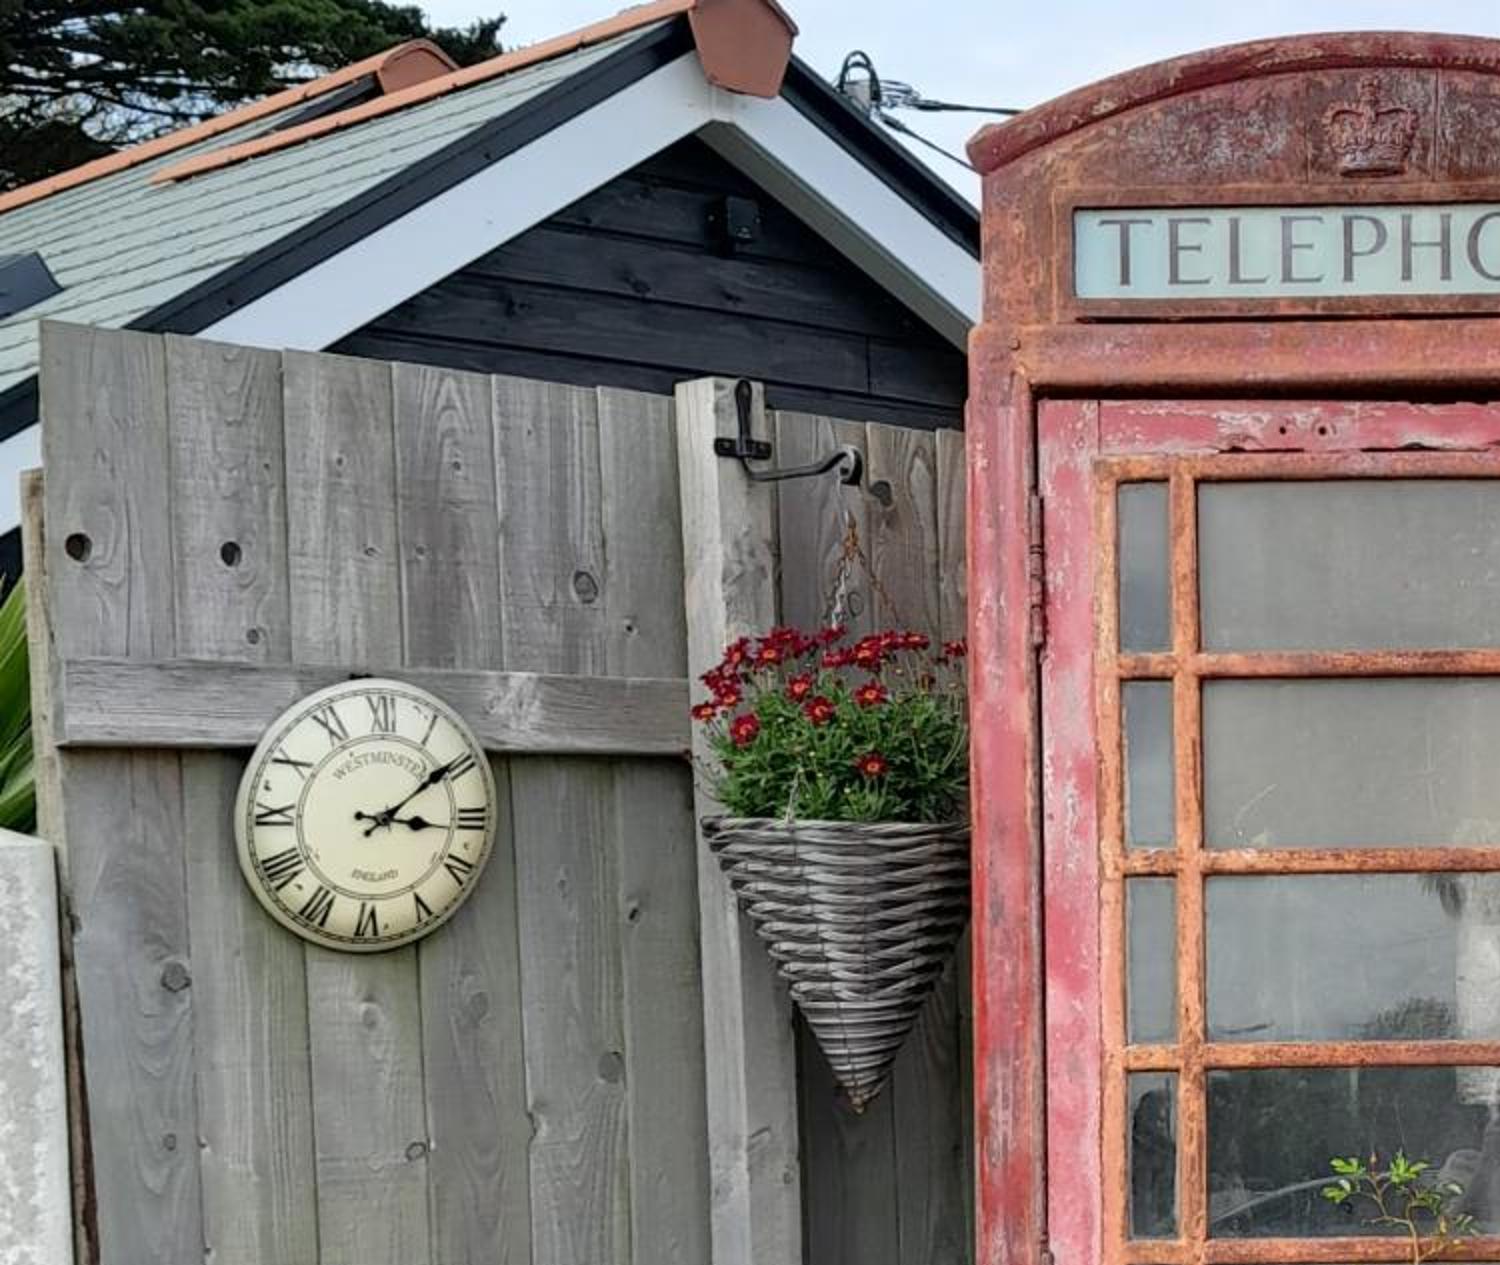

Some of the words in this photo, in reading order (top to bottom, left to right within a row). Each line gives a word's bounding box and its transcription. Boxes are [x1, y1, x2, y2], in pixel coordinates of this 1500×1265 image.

[312, 705, 349, 747] XI
[366, 695, 396, 733] XII
[272, 747, 313, 782] X
[255, 803, 296, 827] IX
[456, 807, 486, 830] III
